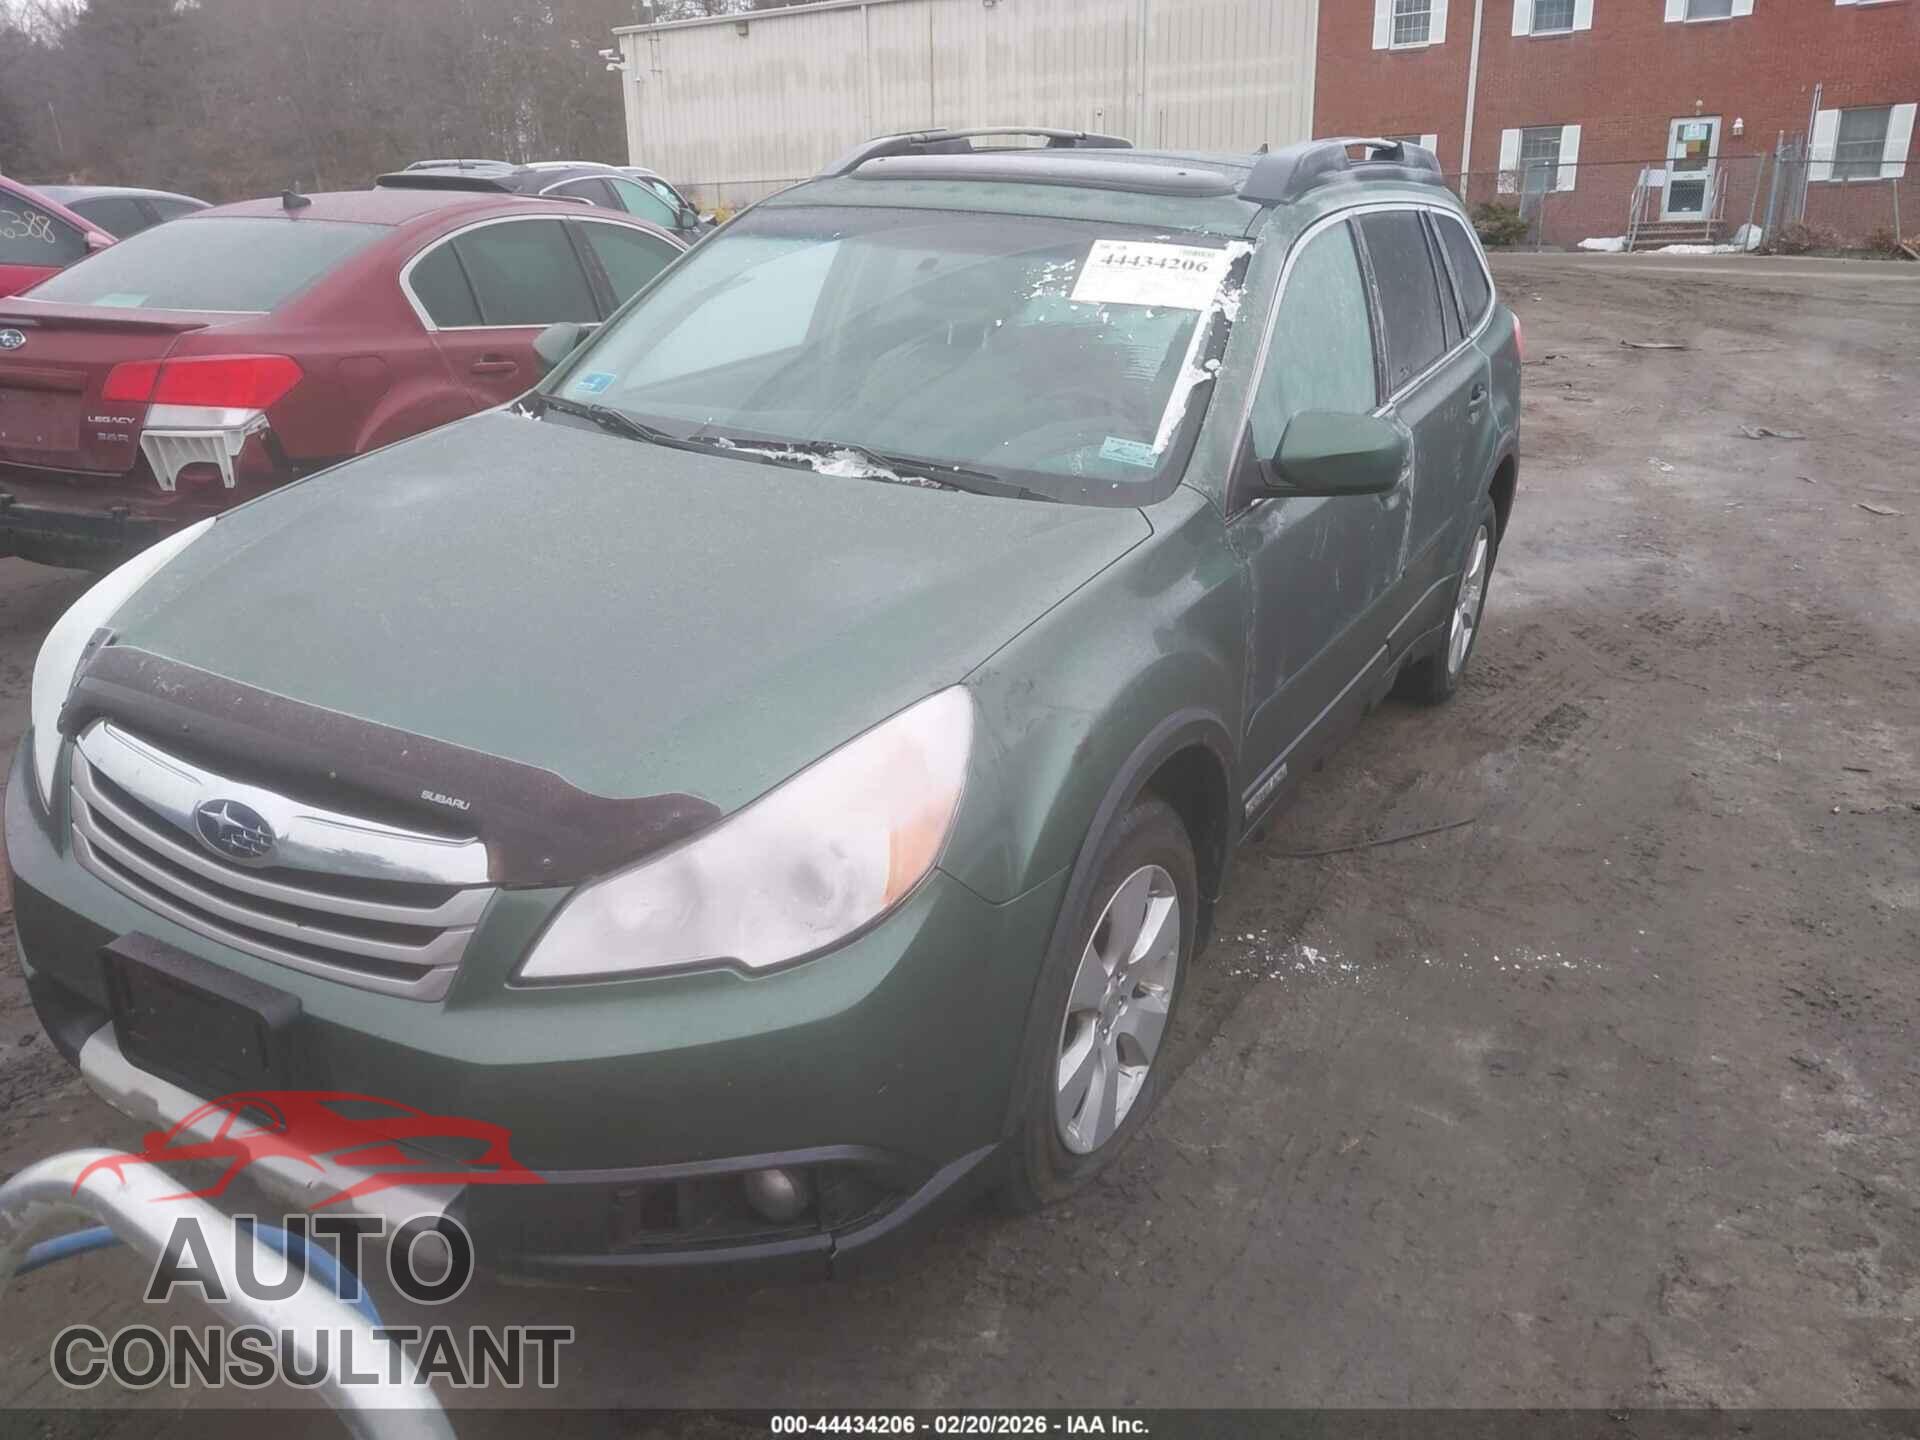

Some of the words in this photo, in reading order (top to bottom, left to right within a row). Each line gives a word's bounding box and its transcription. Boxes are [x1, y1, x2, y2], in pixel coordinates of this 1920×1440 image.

[1099, 253, 1209, 273] 44434206
[87, 415, 136, 425] LEGACY
[420, 790, 470, 811] SUBARU
